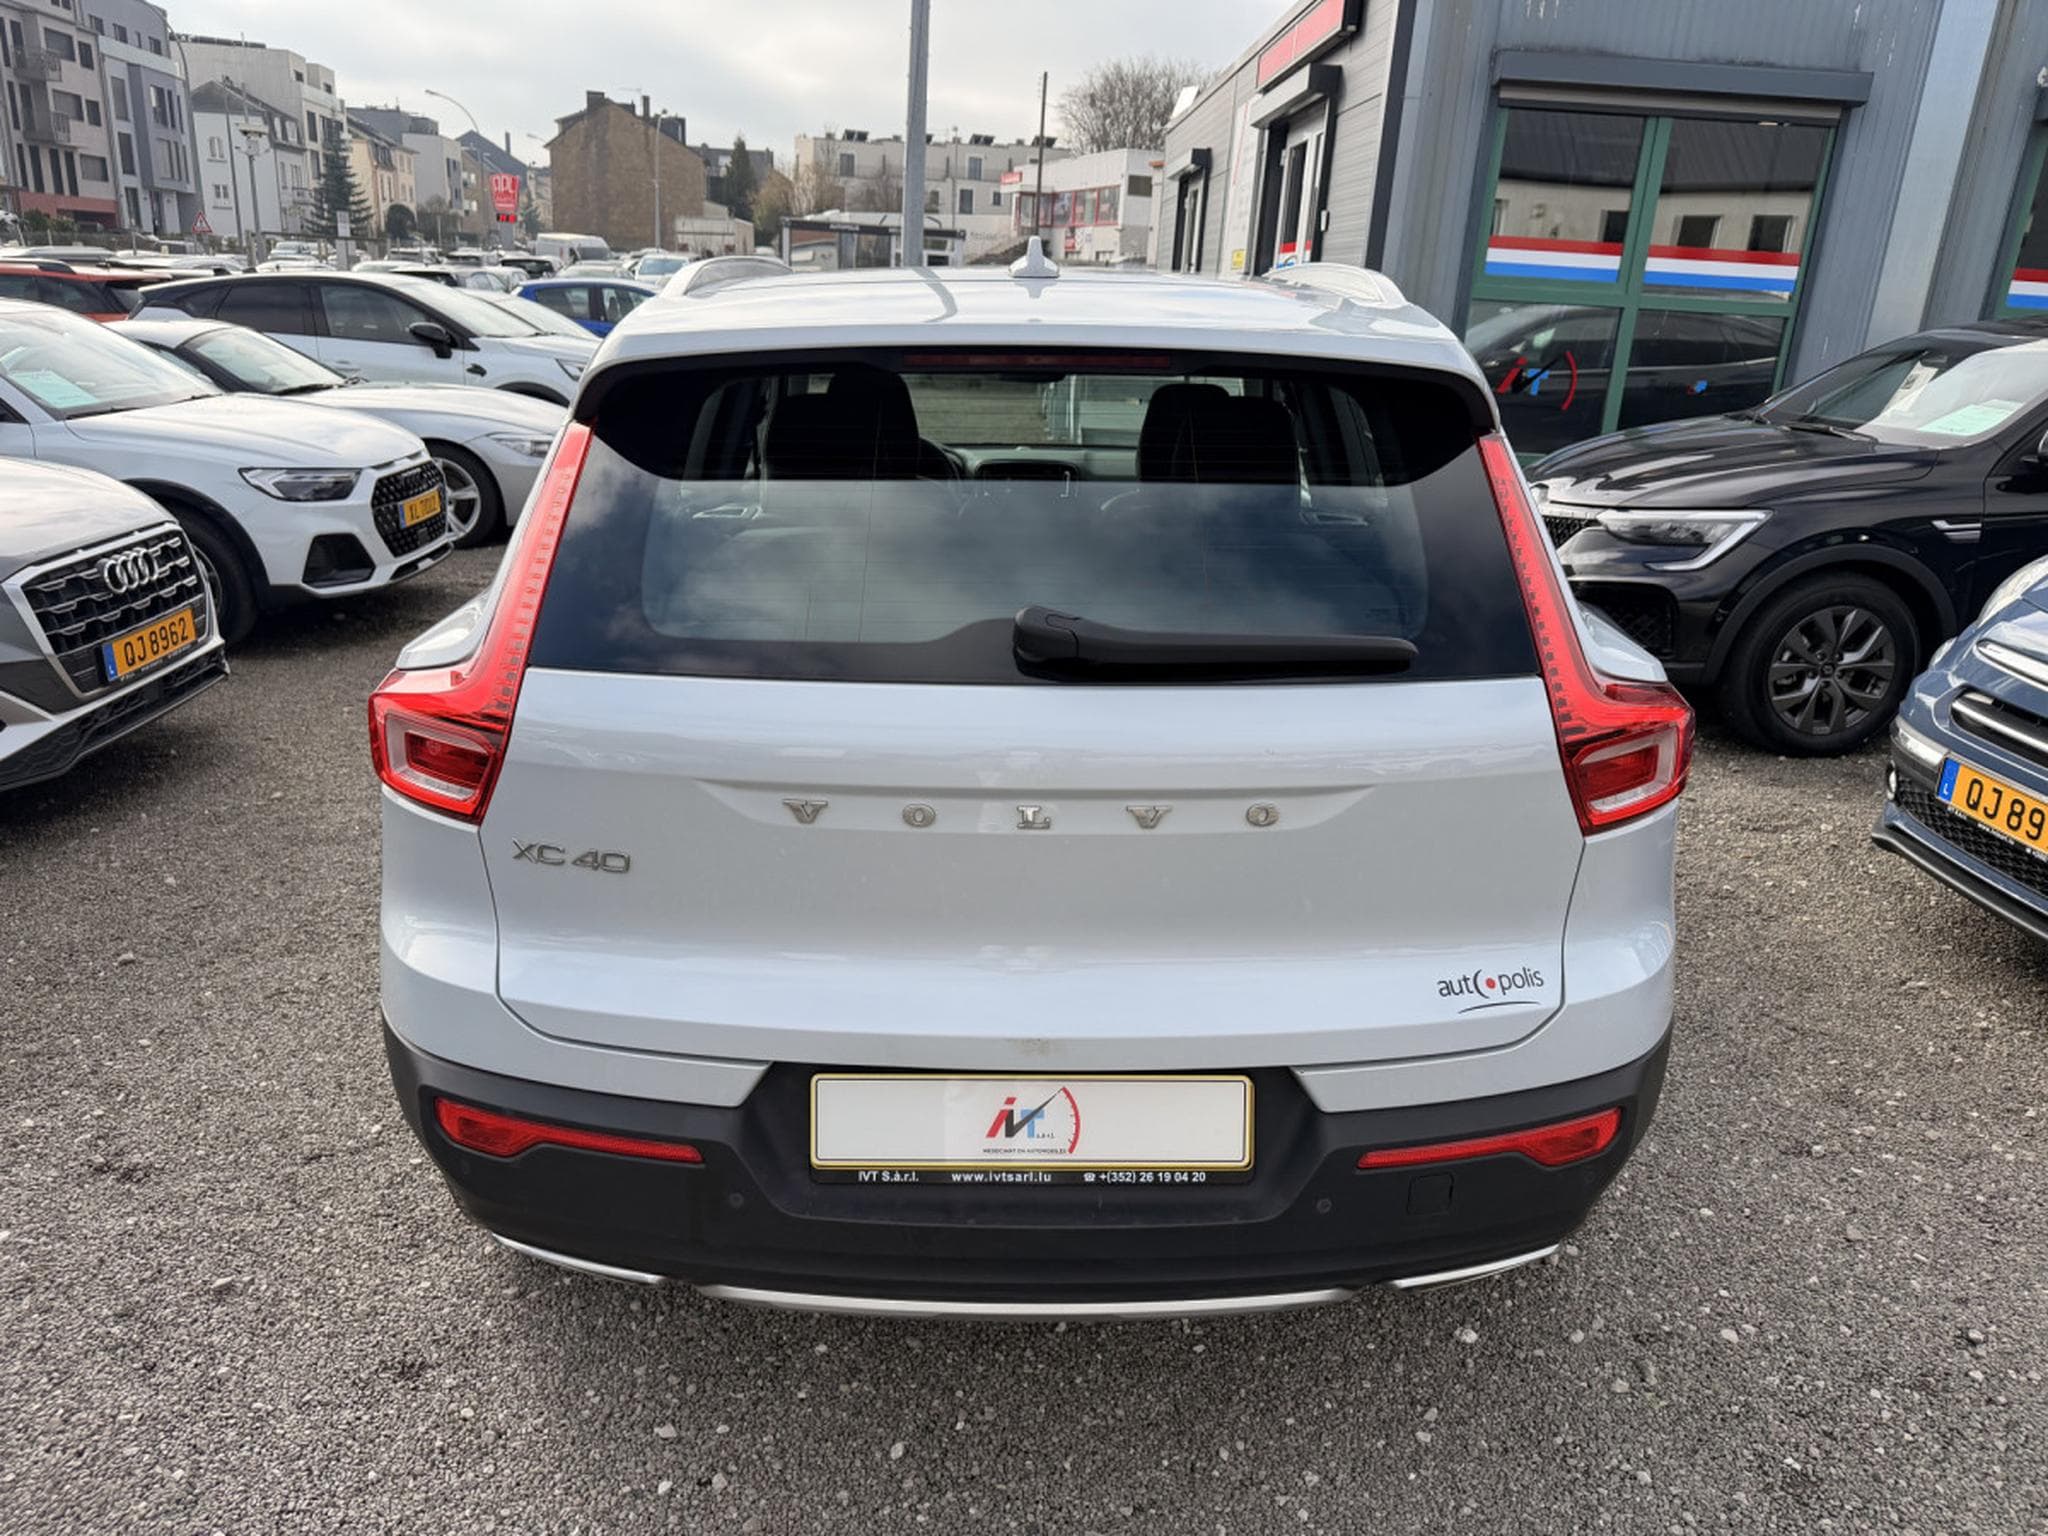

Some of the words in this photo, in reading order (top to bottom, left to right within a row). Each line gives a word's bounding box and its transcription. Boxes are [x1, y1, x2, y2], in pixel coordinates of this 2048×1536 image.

[782, 799, 1280, 831] VOLVO
[2006, 798, 2047, 842] 89
[858, 1170, 878, 1182] IVT
[951, 1170, 1052, 1183] www.ivtsarl.lu
[1139, 1171, 1154, 1183] 26
[1157, 1171, 1172, 1183] 19
[1173, 1171, 1189, 1183] 04
[1191, 1171, 1207, 1183] 20
